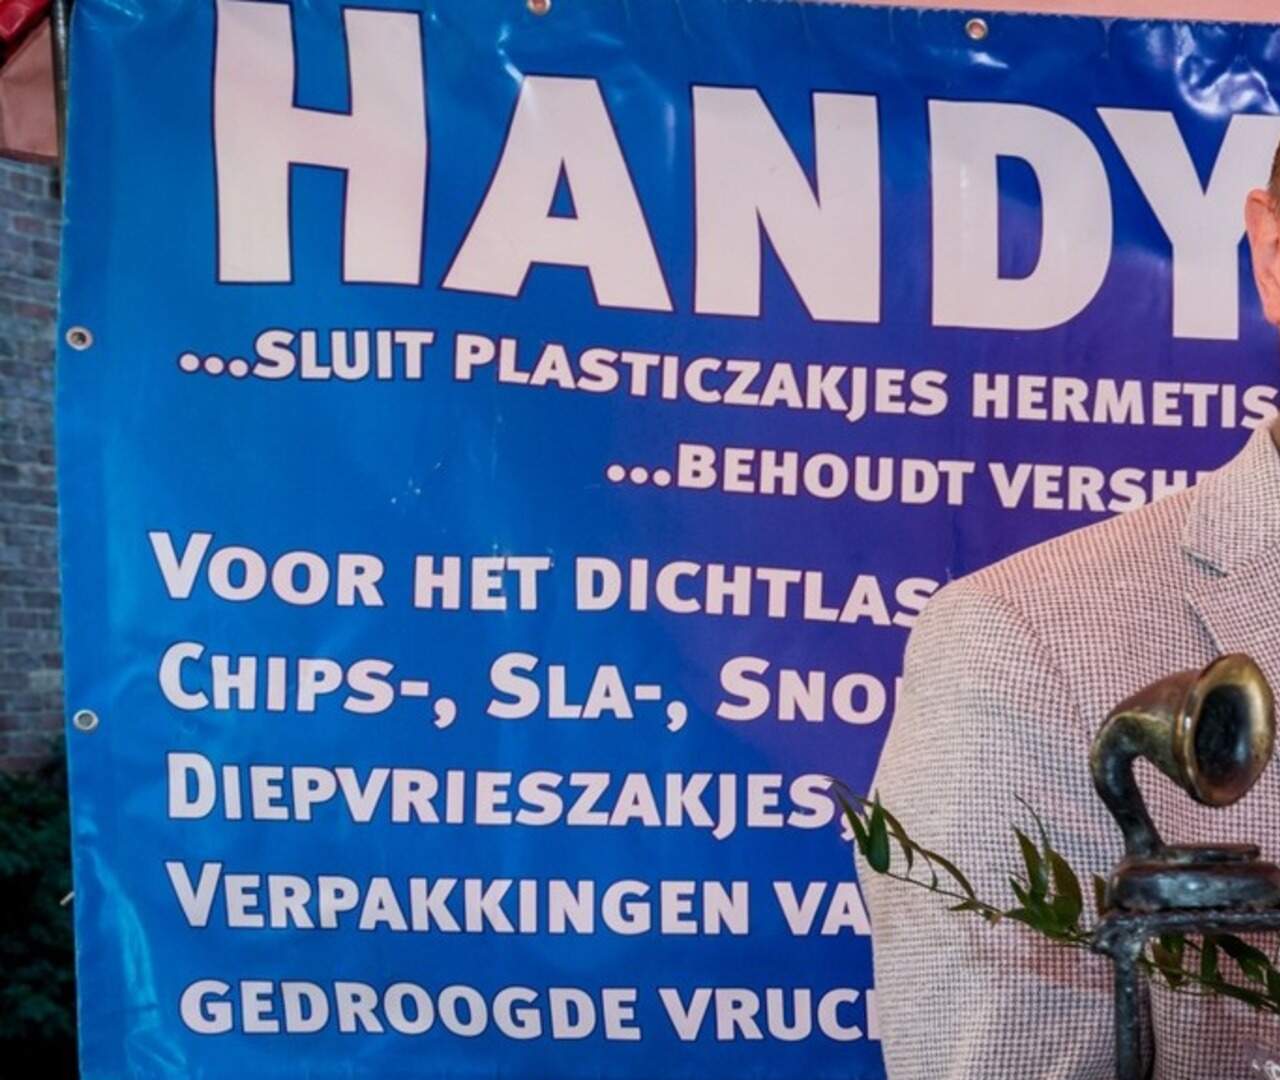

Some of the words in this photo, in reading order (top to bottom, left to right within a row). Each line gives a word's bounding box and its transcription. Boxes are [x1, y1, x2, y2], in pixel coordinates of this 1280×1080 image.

[454, 333, 949, 423] PLASTICZAKJES
[972, 373, 1280, 429] HERMETIS
[148, 531, 386, 607] VOOR
[414, 553, 550, 612] HET
[576, 555, 940, 629] DICHTLAS
[158, 642, 459, 729] CHIPS-,
[486, 652, 690, 733] SLA-,
[716, 656, 903, 724] SNO
[166, 861, 749, 936] VERPAKKINGEN
[773, 881, 872, 936] VA
[180, 980, 640, 1041] GEDROOGDE
[658, 987, 881, 1042] VRUC
